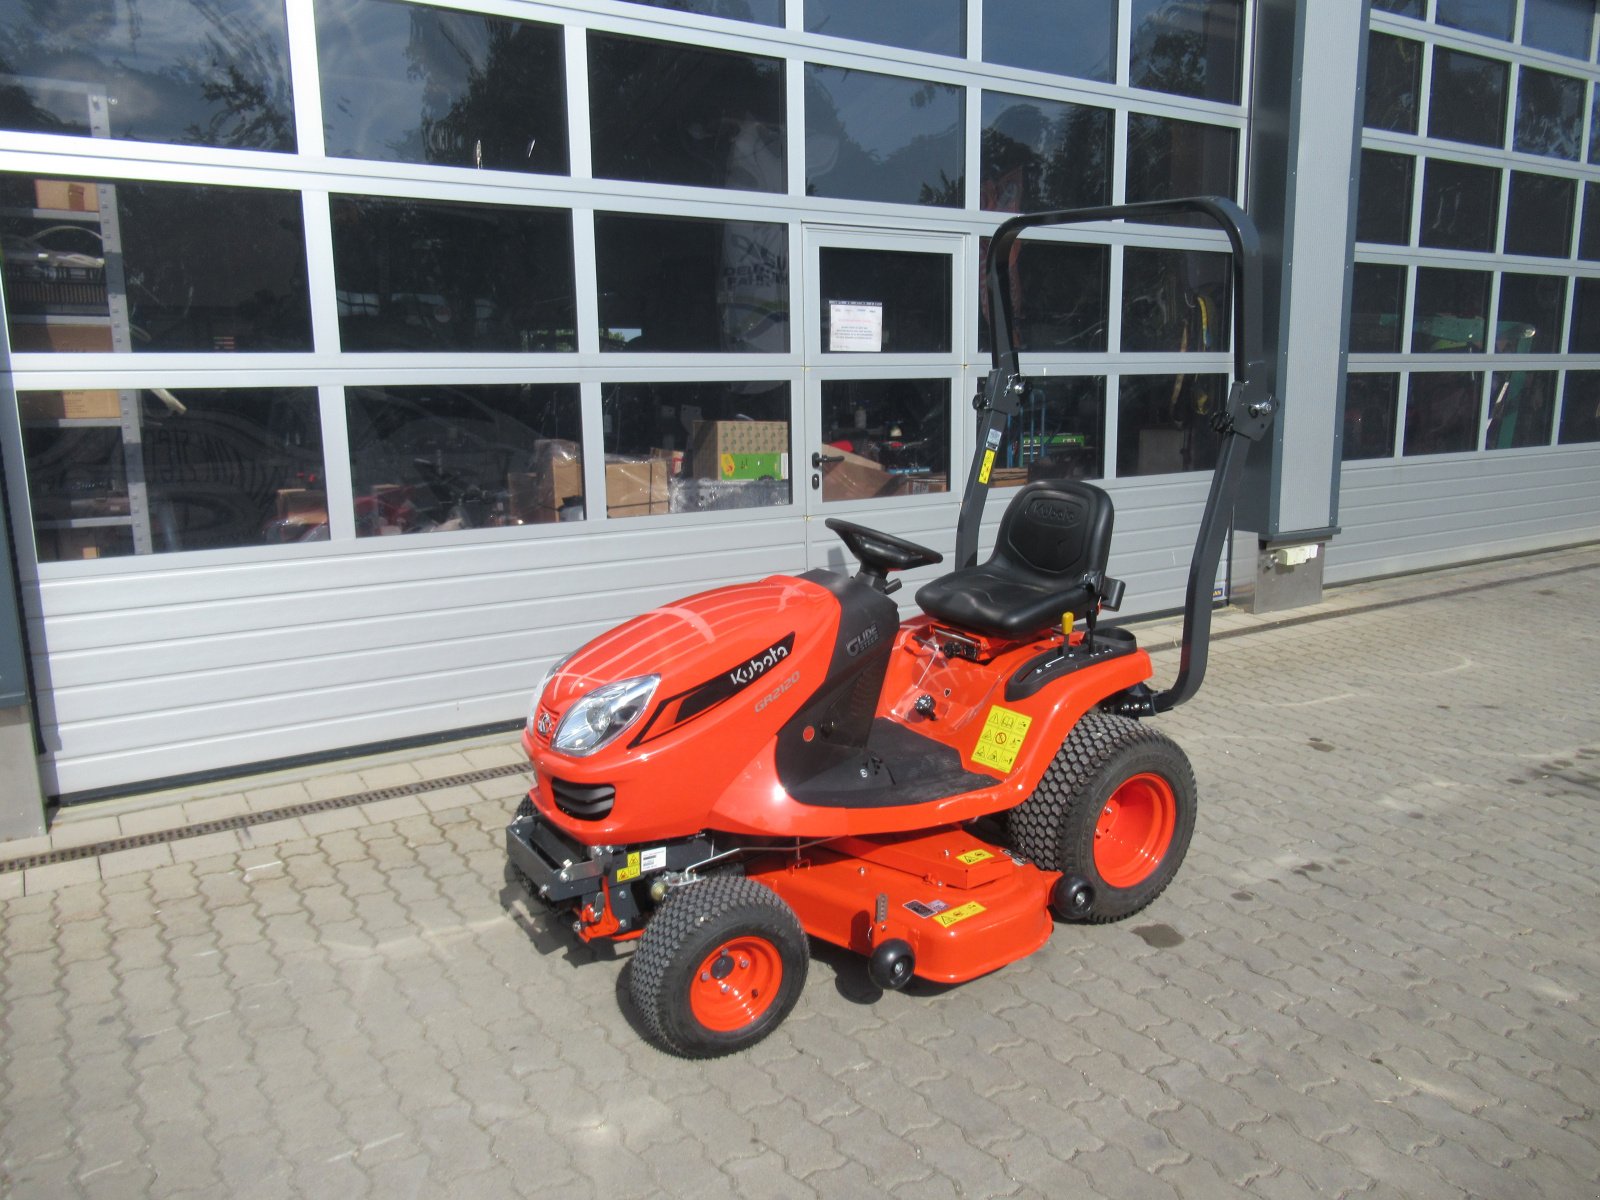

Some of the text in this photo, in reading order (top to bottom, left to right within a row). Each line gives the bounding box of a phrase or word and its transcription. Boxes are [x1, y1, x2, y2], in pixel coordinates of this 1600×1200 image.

[1033, 503, 1076, 523] Kubota
[847, 624, 877, 657] GLIDE
[730, 646, 788, 685] Kubota
[754, 670, 800, 713] GR2120
